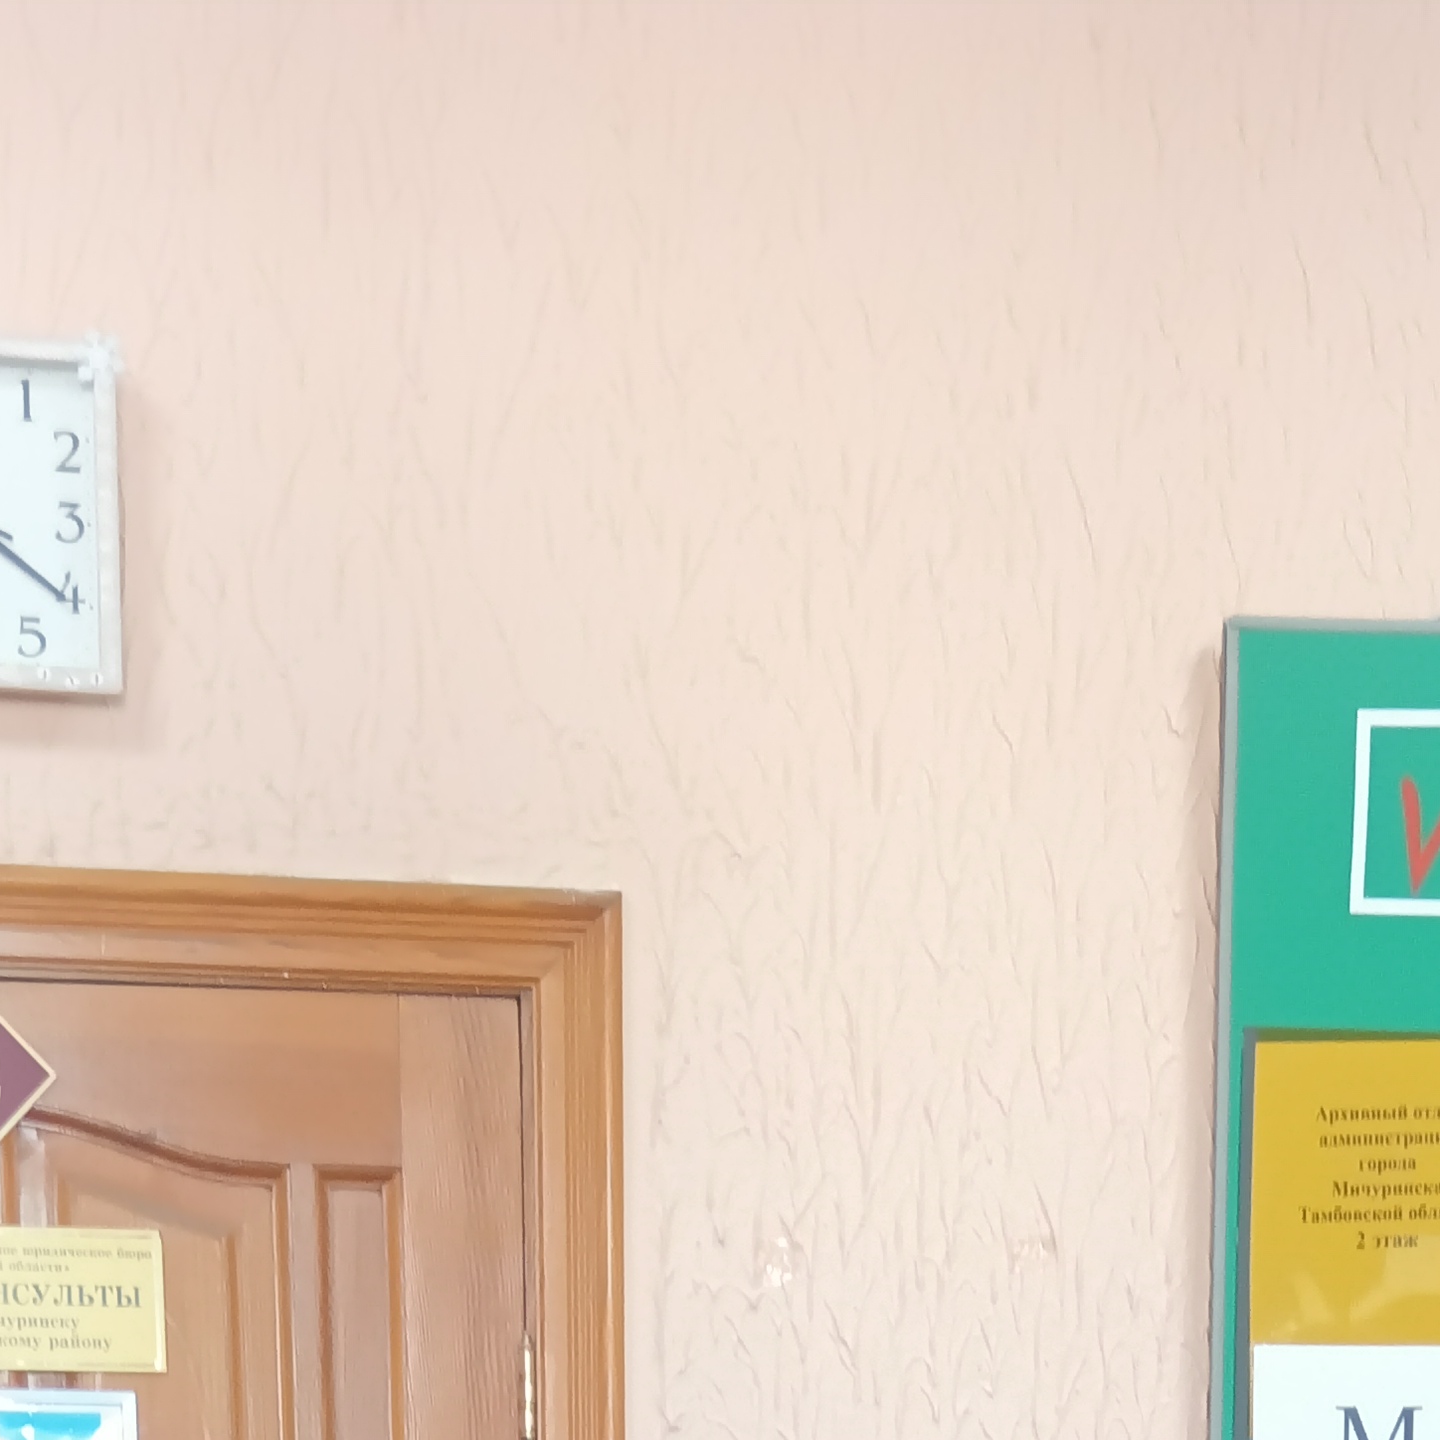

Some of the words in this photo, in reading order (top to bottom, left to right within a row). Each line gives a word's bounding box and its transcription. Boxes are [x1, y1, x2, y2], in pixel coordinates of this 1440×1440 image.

[20, 379, 33, 422] 1
[52, 431, 81, 474] 2
[55, 501, 85, 544] 3
[59, 571, 87, 615] 4
[17, 615, 47, 658] 5
[1315, 1104, 1408, 1126] Архивный
[1358, 1158, 1417, 1175] города
[1298, 1203, 1404, 1224] Тамбовской
